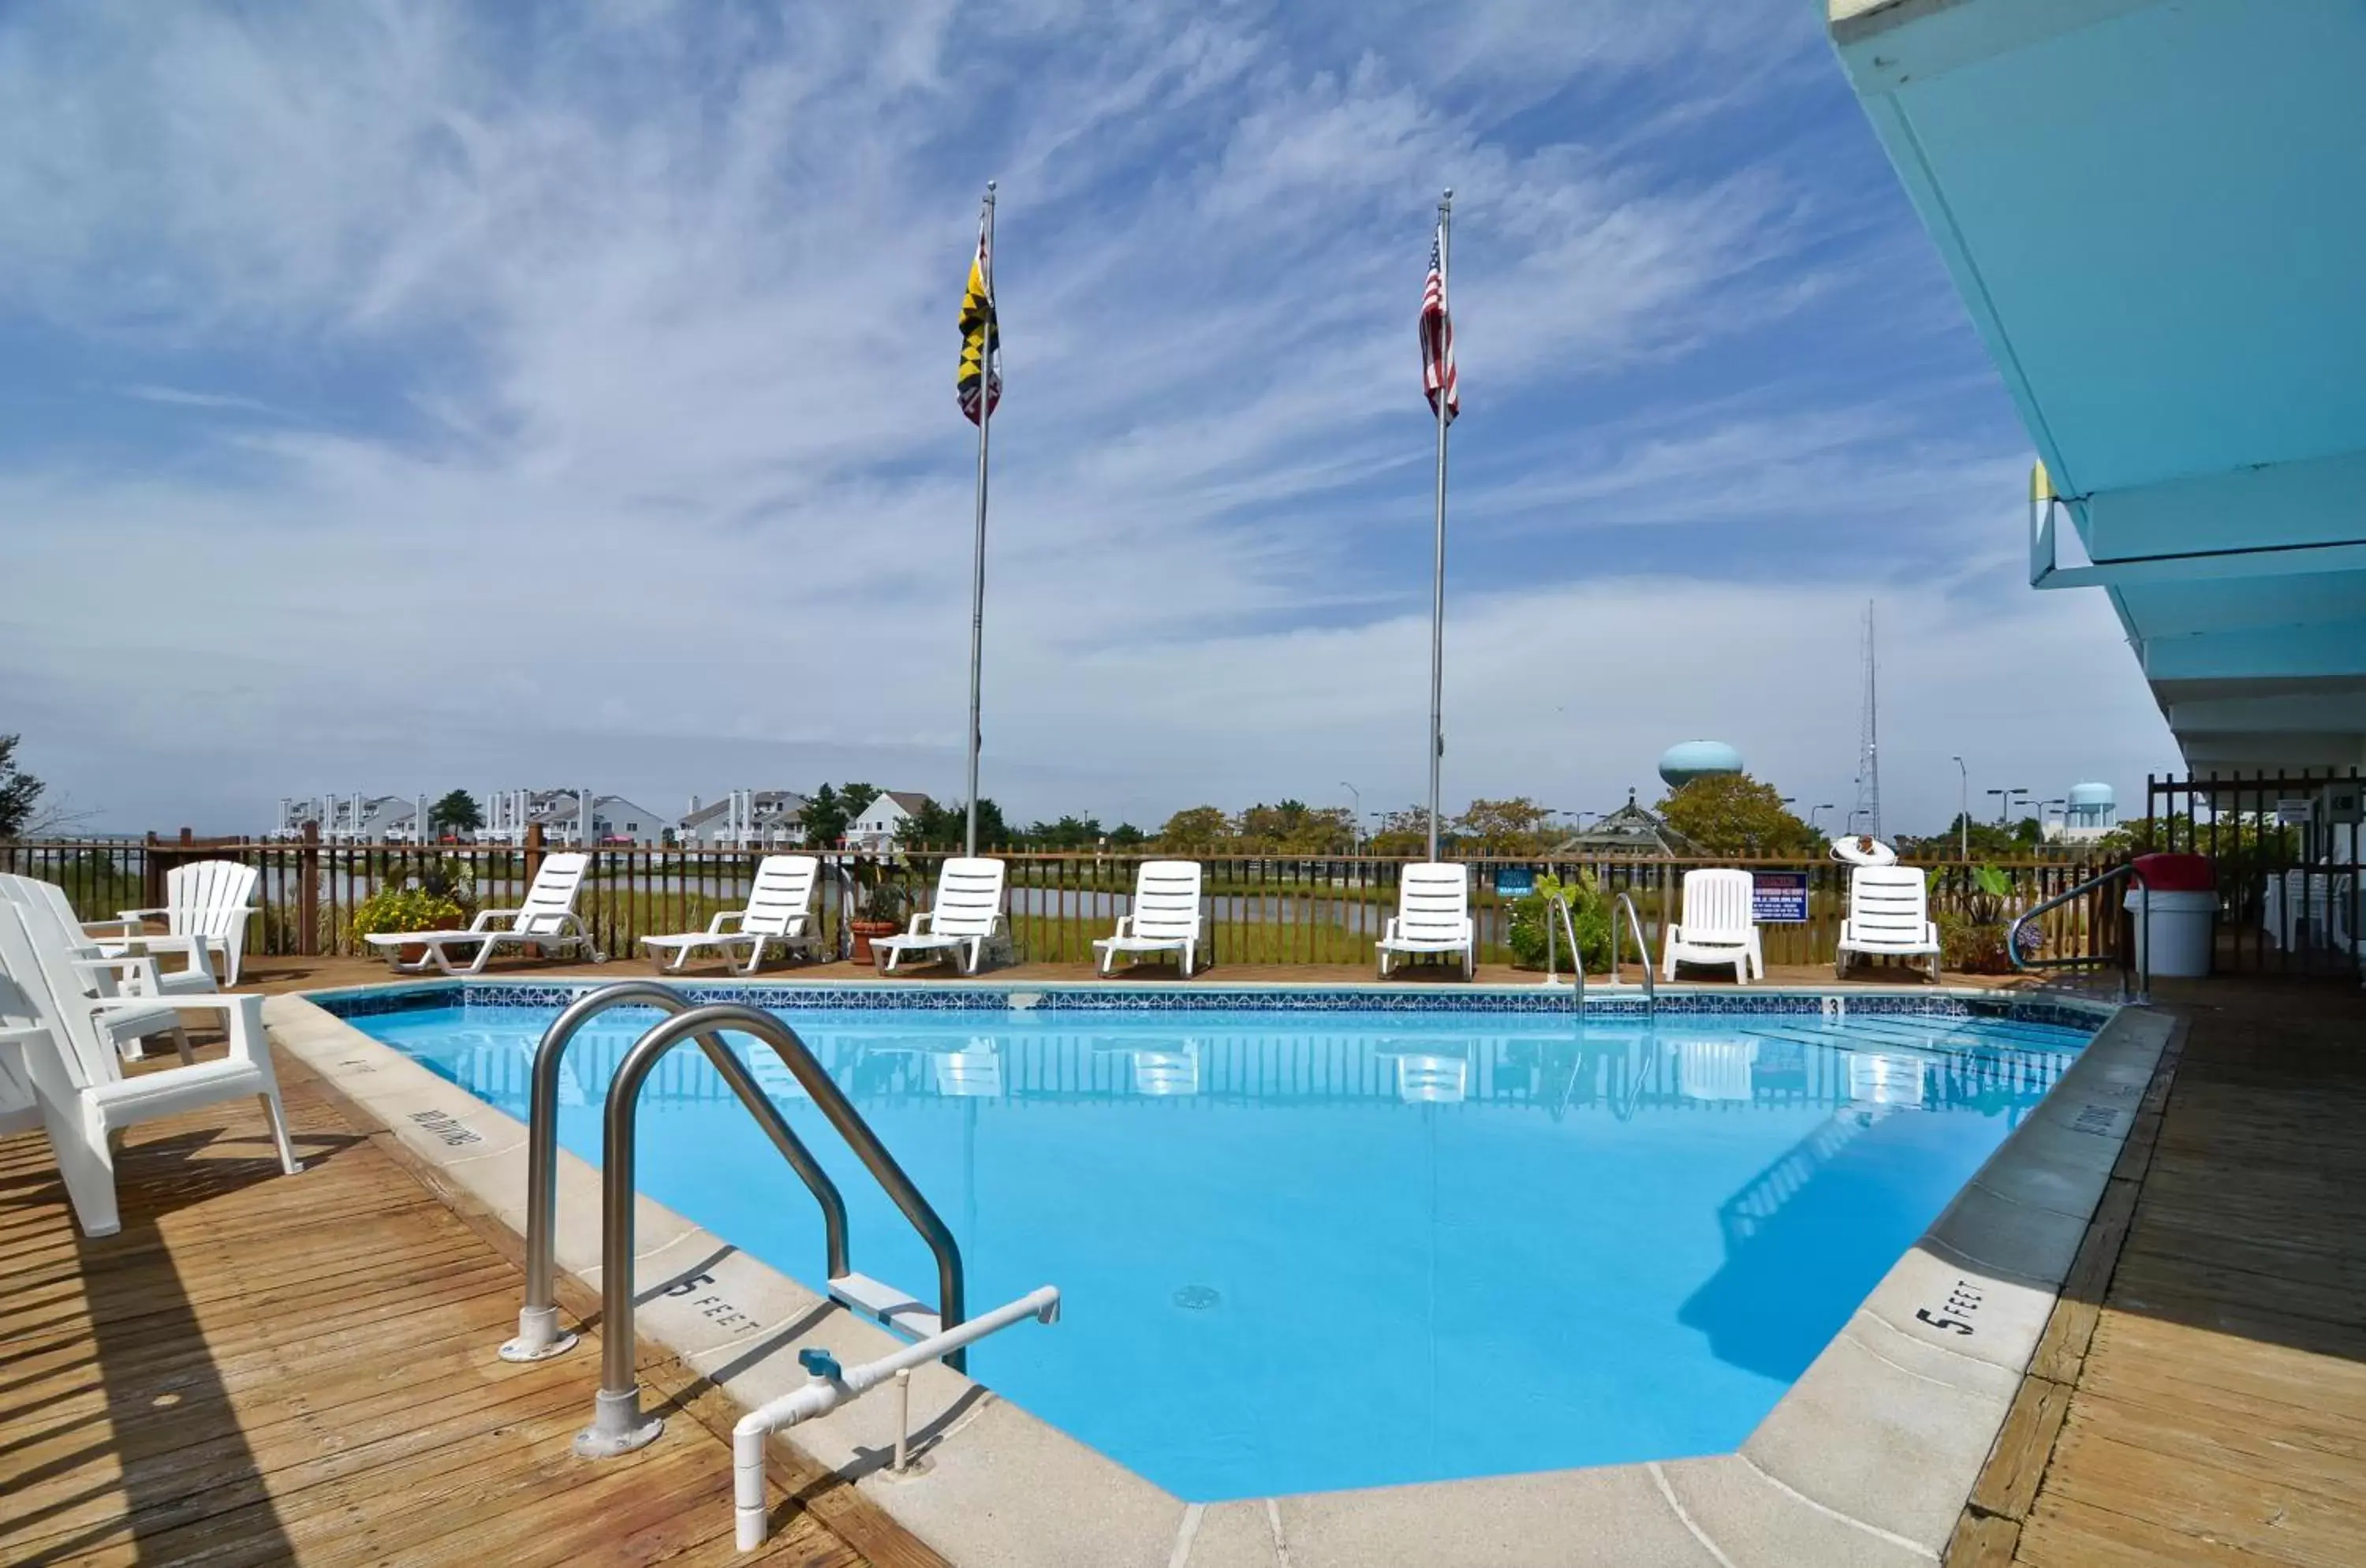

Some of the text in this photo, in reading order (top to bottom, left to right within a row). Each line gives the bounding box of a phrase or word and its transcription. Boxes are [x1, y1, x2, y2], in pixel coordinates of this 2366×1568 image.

[1830, 998, 1838, 1015] 3
[662, 1274, 760, 1334] 5 FEET
[1916, 1279, 1985, 1335] 5 FEET
